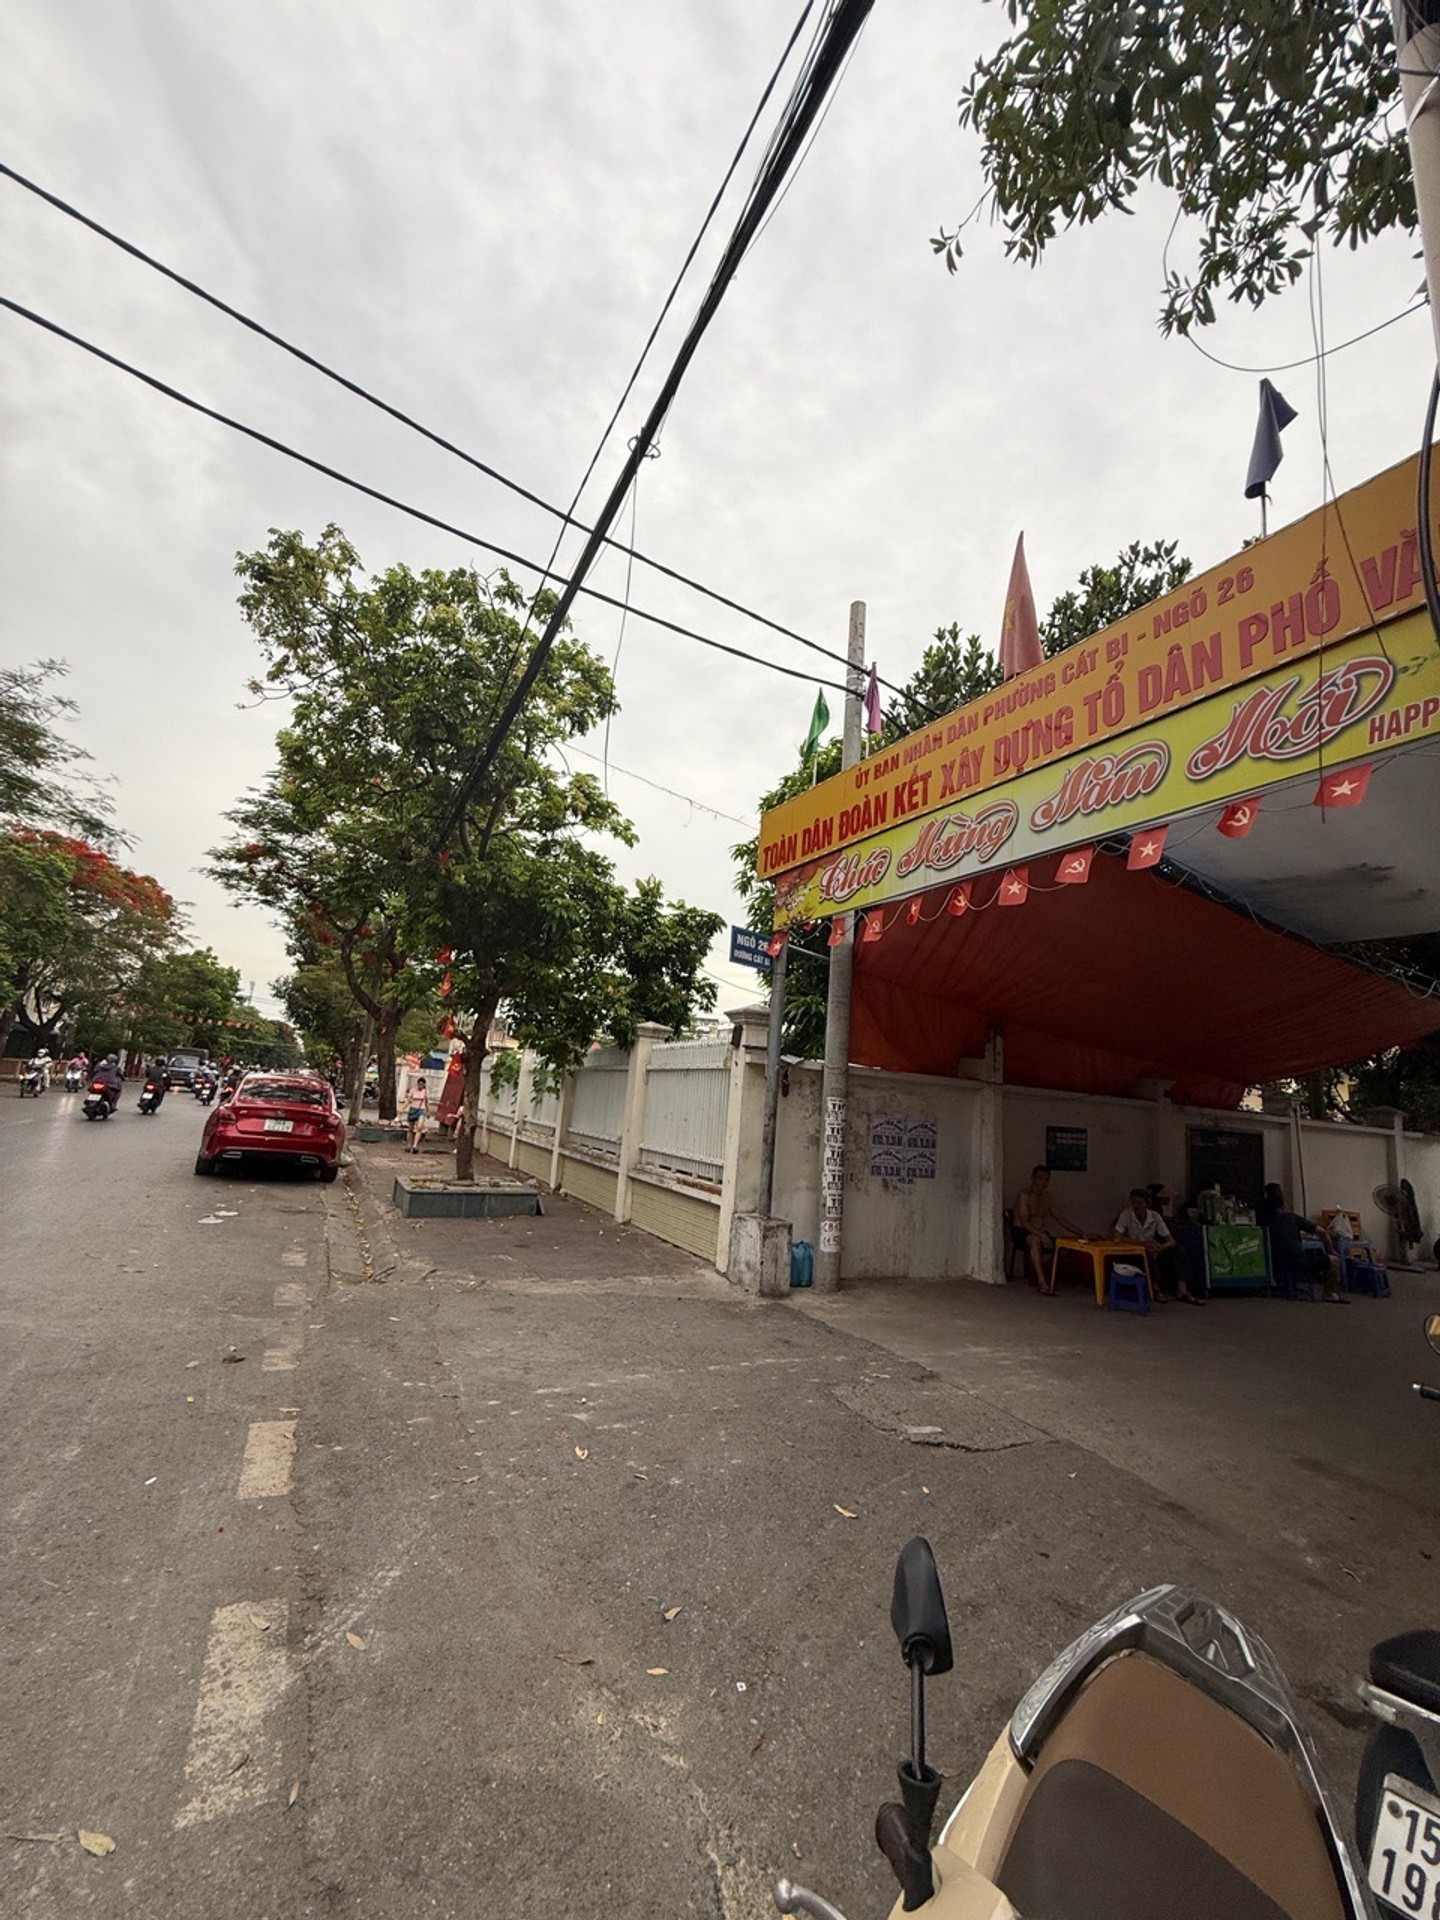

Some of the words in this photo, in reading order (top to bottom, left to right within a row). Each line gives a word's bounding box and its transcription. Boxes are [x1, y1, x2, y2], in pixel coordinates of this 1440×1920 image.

[763, 830, 798, 873] TOÀN
[801, 817, 834, 858] DÂN
[838, 791, 887, 841] ĐOÀN
[893, 764, 932, 818] KẾT
[939, 745, 985, 799] XÂY
[993, 705, 1074, 777] DỰNG
[1083, 659, 1125, 736] TỔ
[1137, 631, 1224, 714] DÂN
[1238, 557, 1341, 669] PHỐ
[1360, 525, 1440, 611] VĂ
[820, 847, 892, 904] Chúc
[1029, 740, 1171, 832] Năm
[1185, 656, 1394, 780] Mới
[874, 753, 900, 781] BAN
[903, 734, 943, 766] NHÂN
[947, 712, 979, 744] DÂN
[983, 671, 1056, 725] PHƯỜNG
[1062, 648, 1099, 685] CÁT
[1105, 633, 1128, 663] BI
[1153, 586, 1207, 639] NGÕ
[1217, 566, 1254, 605] 26
[1405, 1809, 1440, 1866] 15
